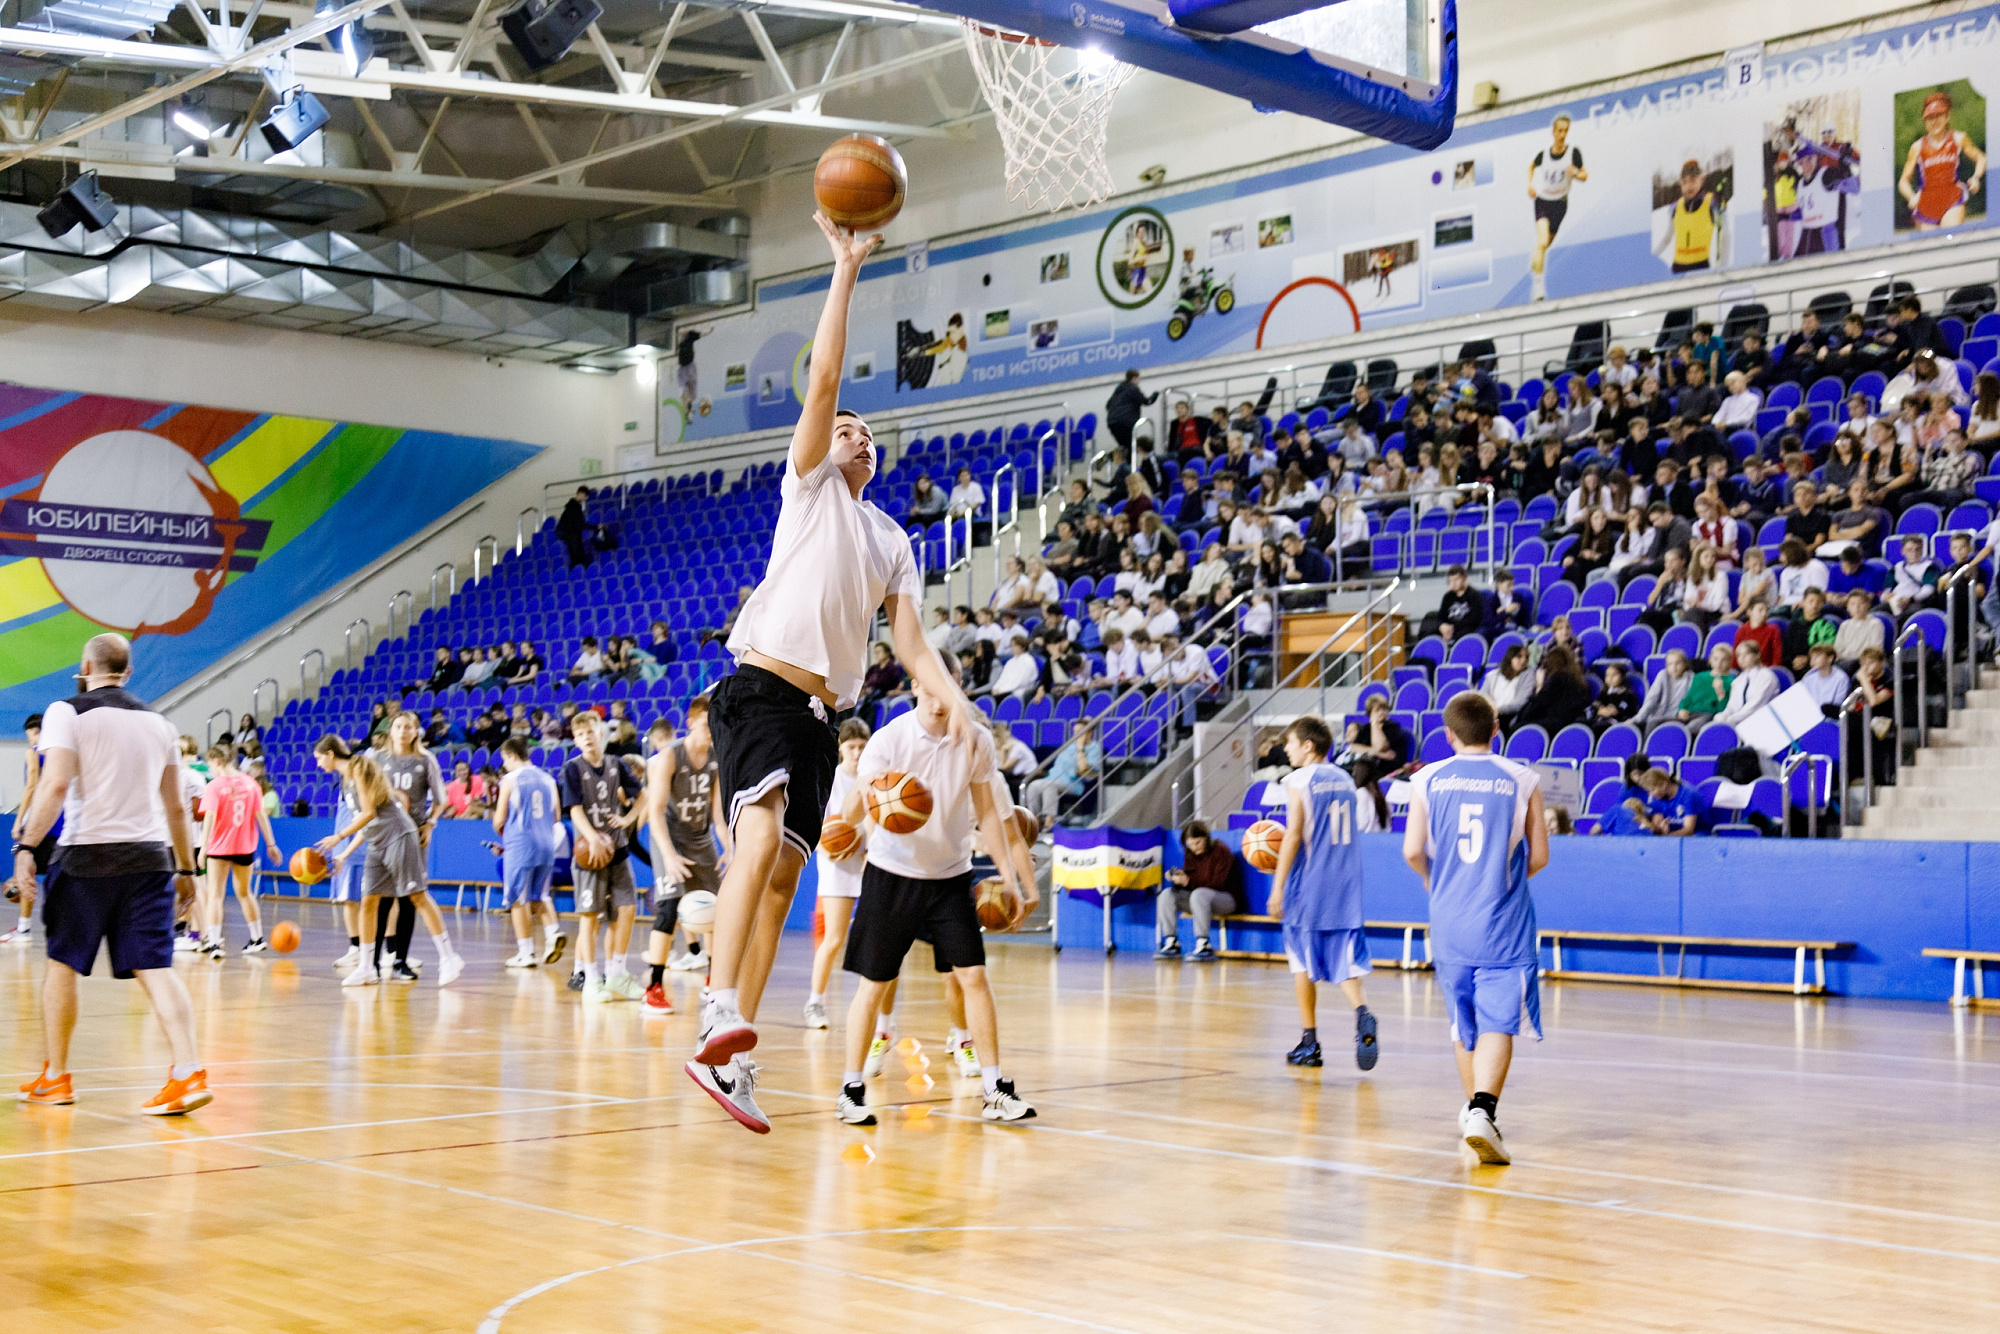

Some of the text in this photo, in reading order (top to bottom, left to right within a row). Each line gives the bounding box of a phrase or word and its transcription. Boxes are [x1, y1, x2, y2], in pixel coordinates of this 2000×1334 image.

[972, 338, 1152, 383] твоя история спорта
[27, 506, 210, 540] ЮБИЛЕЙНЫЙ
[63, 546, 184, 565] ДВОРЕЦ СПОРТА
[392, 771, 413, 791] 10
[596, 780, 609, 800] 3
[689, 773, 710, 795] 12
[1493, 778, 1515, 796] СОШ
[233, 800, 245, 827] 8
[532, 790, 544, 819] 9
[1328, 800, 1351, 845] 11
[1457, 803, 1484, 864] 5
[656, 876, 677, 896] 12
[581, 889, 594, 909] 3
